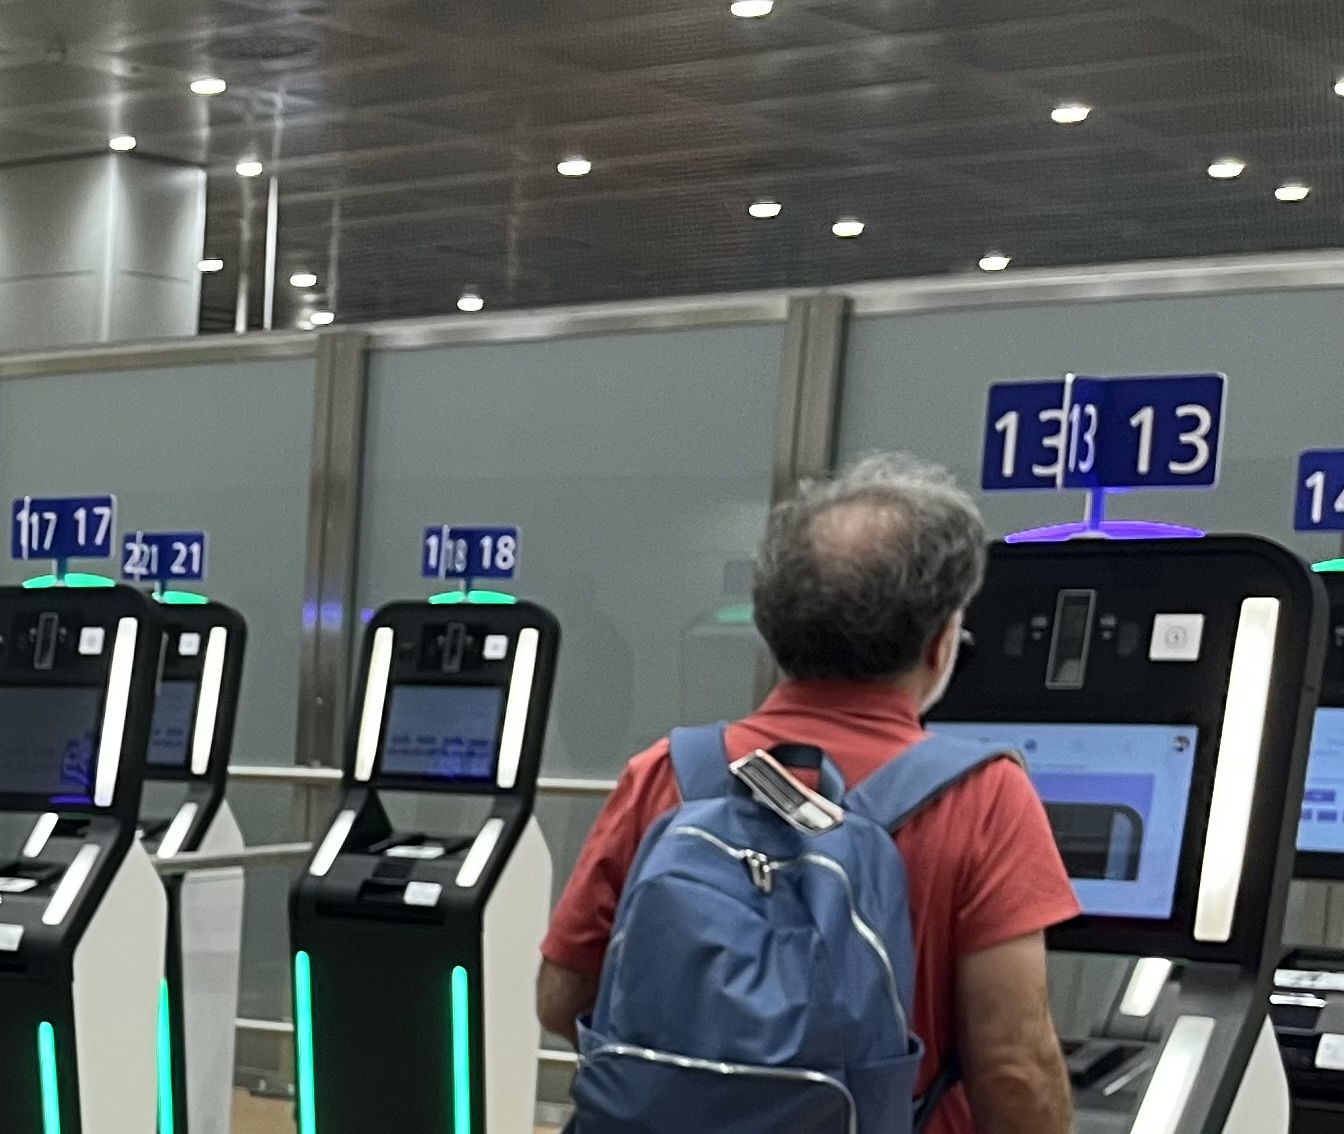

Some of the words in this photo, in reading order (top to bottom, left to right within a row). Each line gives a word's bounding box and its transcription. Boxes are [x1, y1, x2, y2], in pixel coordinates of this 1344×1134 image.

[1130, 404, 1211, 475] 13
[74, 507, 111, 546] 17
[170, 541, 201, 574] 21
[479, 535, 516, 570] 18
